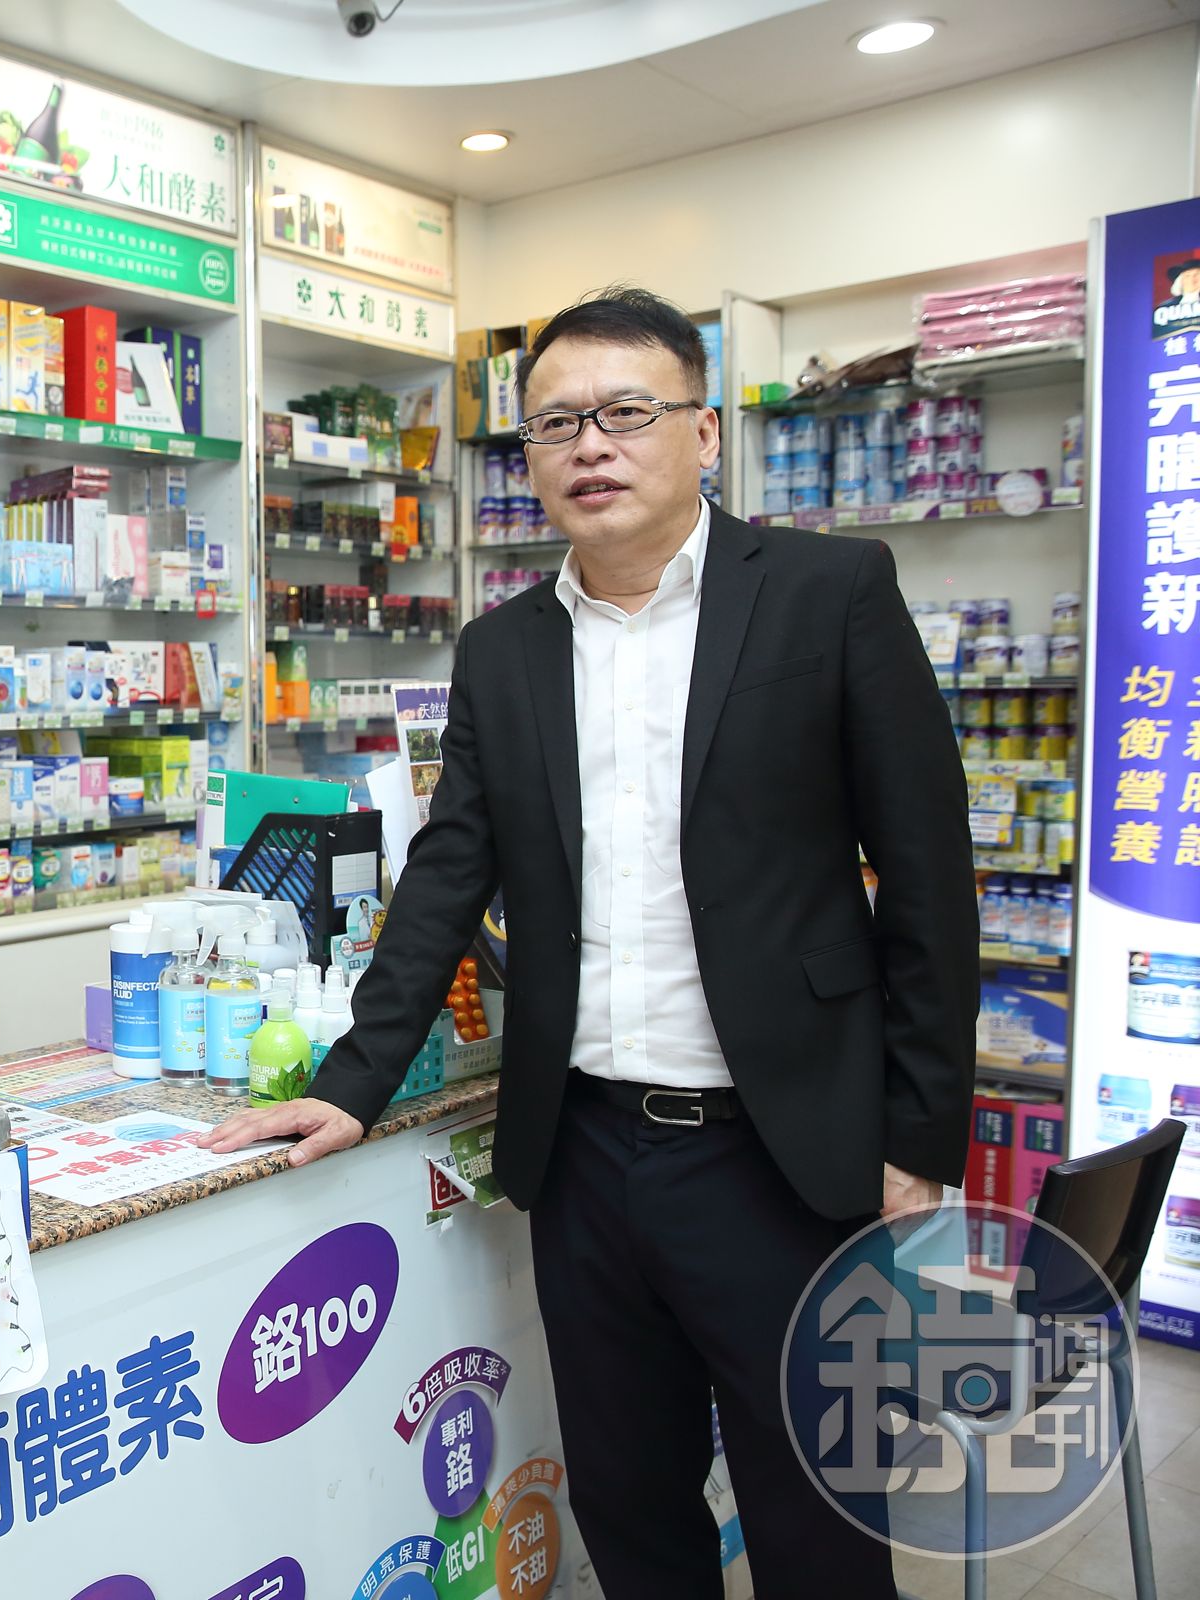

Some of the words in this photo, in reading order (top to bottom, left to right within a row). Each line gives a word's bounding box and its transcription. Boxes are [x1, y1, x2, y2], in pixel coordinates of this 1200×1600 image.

[104, 153, 227, 224] 大和酵素
[328, 286, 430, 338] 大和酵素
[1110, 665, 1175, 865] 均衡營養
[113, 990, 133, 999] FLUID
[250, 1283, 378, 1395] 鉻100
[440, 1406, 474, 1449] 專利
[445, 1442, 474, 1498] 鉻
[445, 1524, 486, 1585] 低GI
[507, 1510, 546, 1556] 不油
[360, 1539, 432, 1599] 明亮保護
[510, 1546, 547, 1595] 不甜
